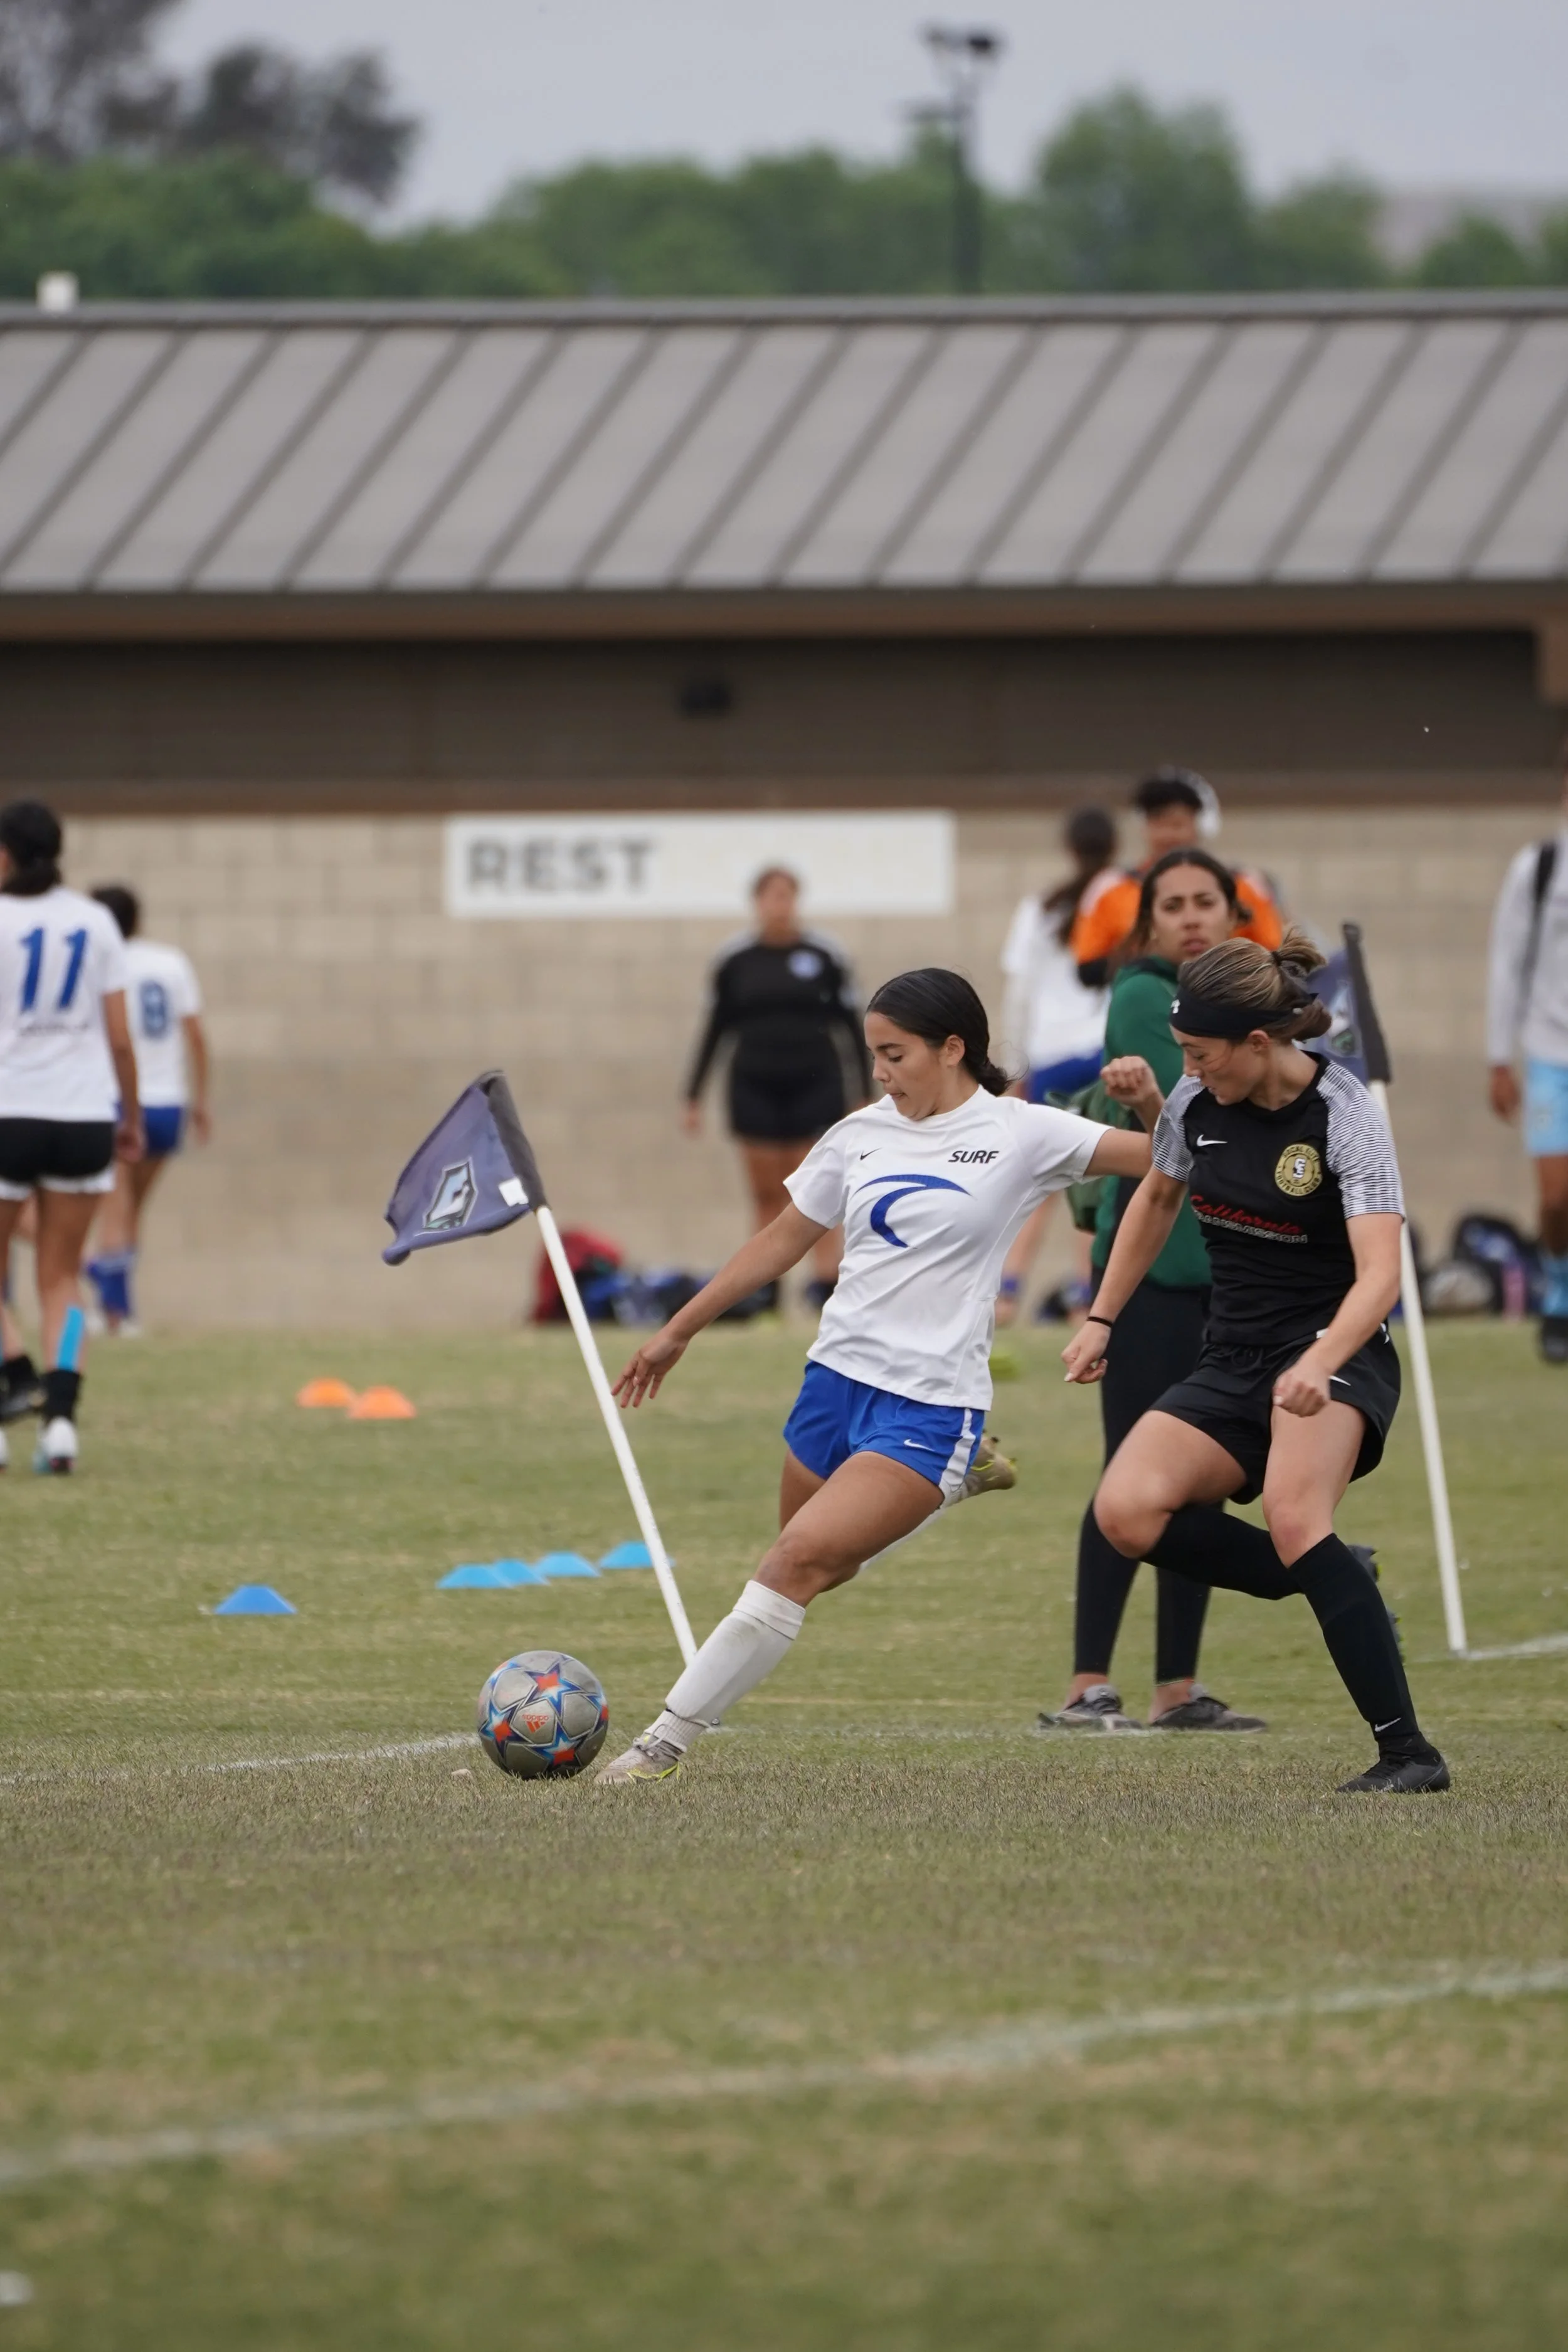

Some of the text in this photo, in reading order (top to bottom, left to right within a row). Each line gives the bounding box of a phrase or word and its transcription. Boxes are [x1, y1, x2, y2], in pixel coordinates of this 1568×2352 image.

[467, 837, 654, 895] REST
[20, 926, 88, 1014] 11
[948, 1150, 999, 1163] SURF
